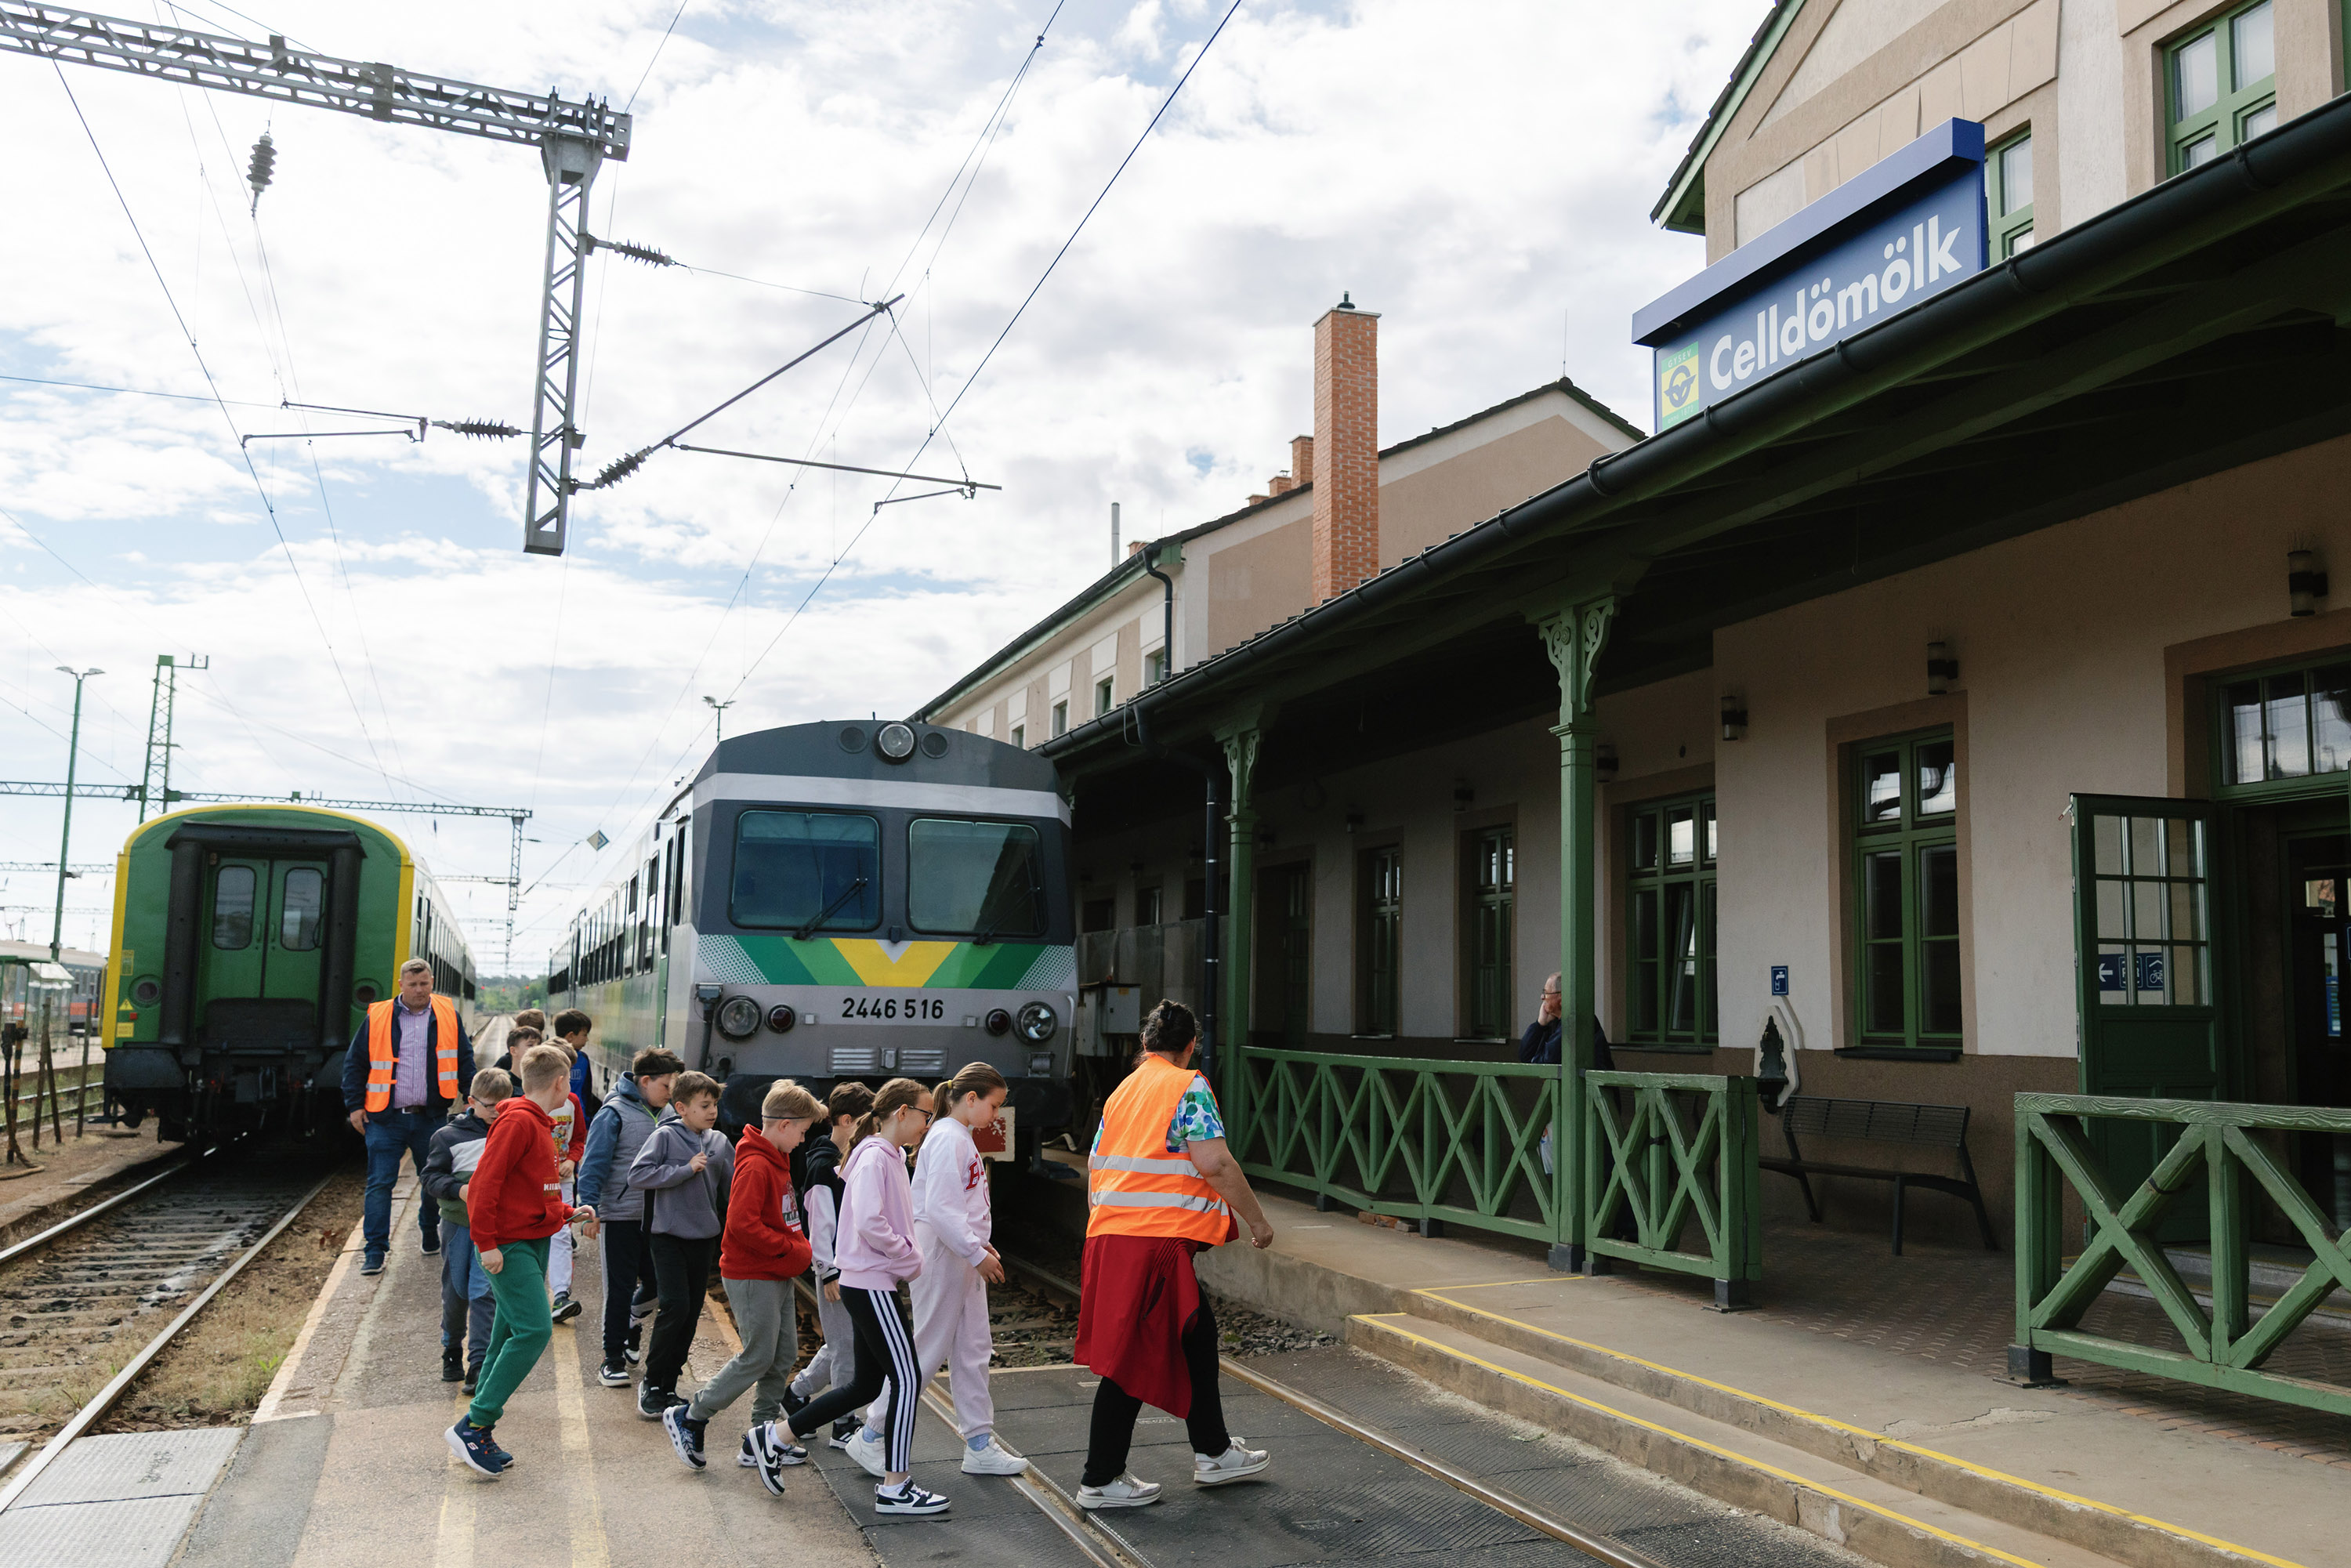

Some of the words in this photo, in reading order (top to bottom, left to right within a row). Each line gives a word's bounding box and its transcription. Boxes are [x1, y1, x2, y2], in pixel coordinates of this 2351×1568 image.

[1709, 214, 1962, 390] Celldömölk
[1668, 349, 1692, 368] GYSEV
[842, 998, 897, 1019] 2446
[904, 999, 944, 1019] 516
